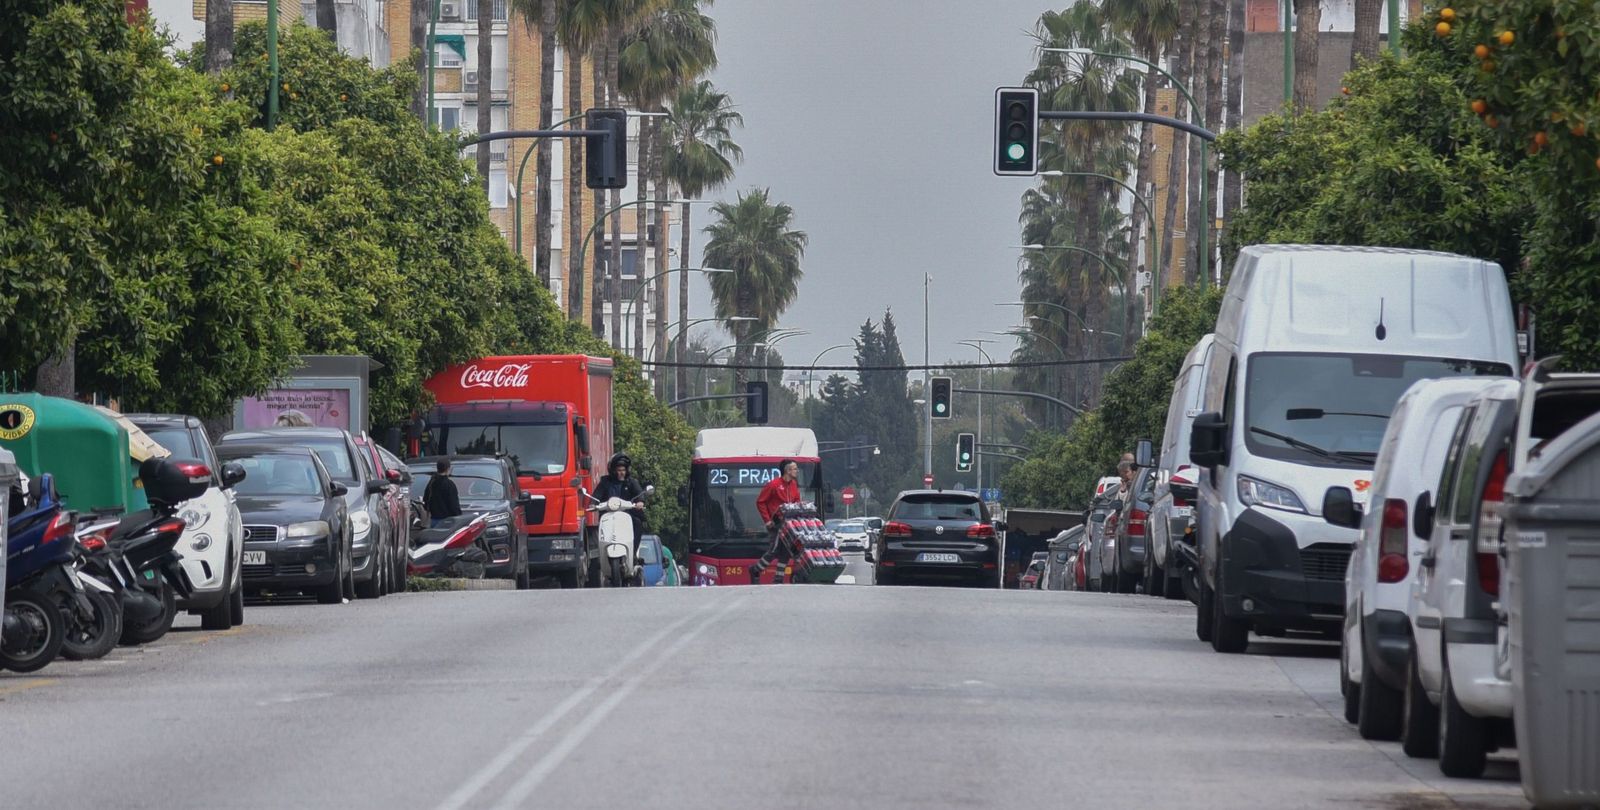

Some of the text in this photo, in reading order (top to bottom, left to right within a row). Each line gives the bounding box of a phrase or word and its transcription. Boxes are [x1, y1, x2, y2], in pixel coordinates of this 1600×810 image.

[461, 364, 532, 388] Coca-Cola
[266, 402, 287, 410] mejor
[3, 424, 30, 438] VIDRIO
[710, 469, 729, 484] 25
[725, 566, 742, 575] 245
